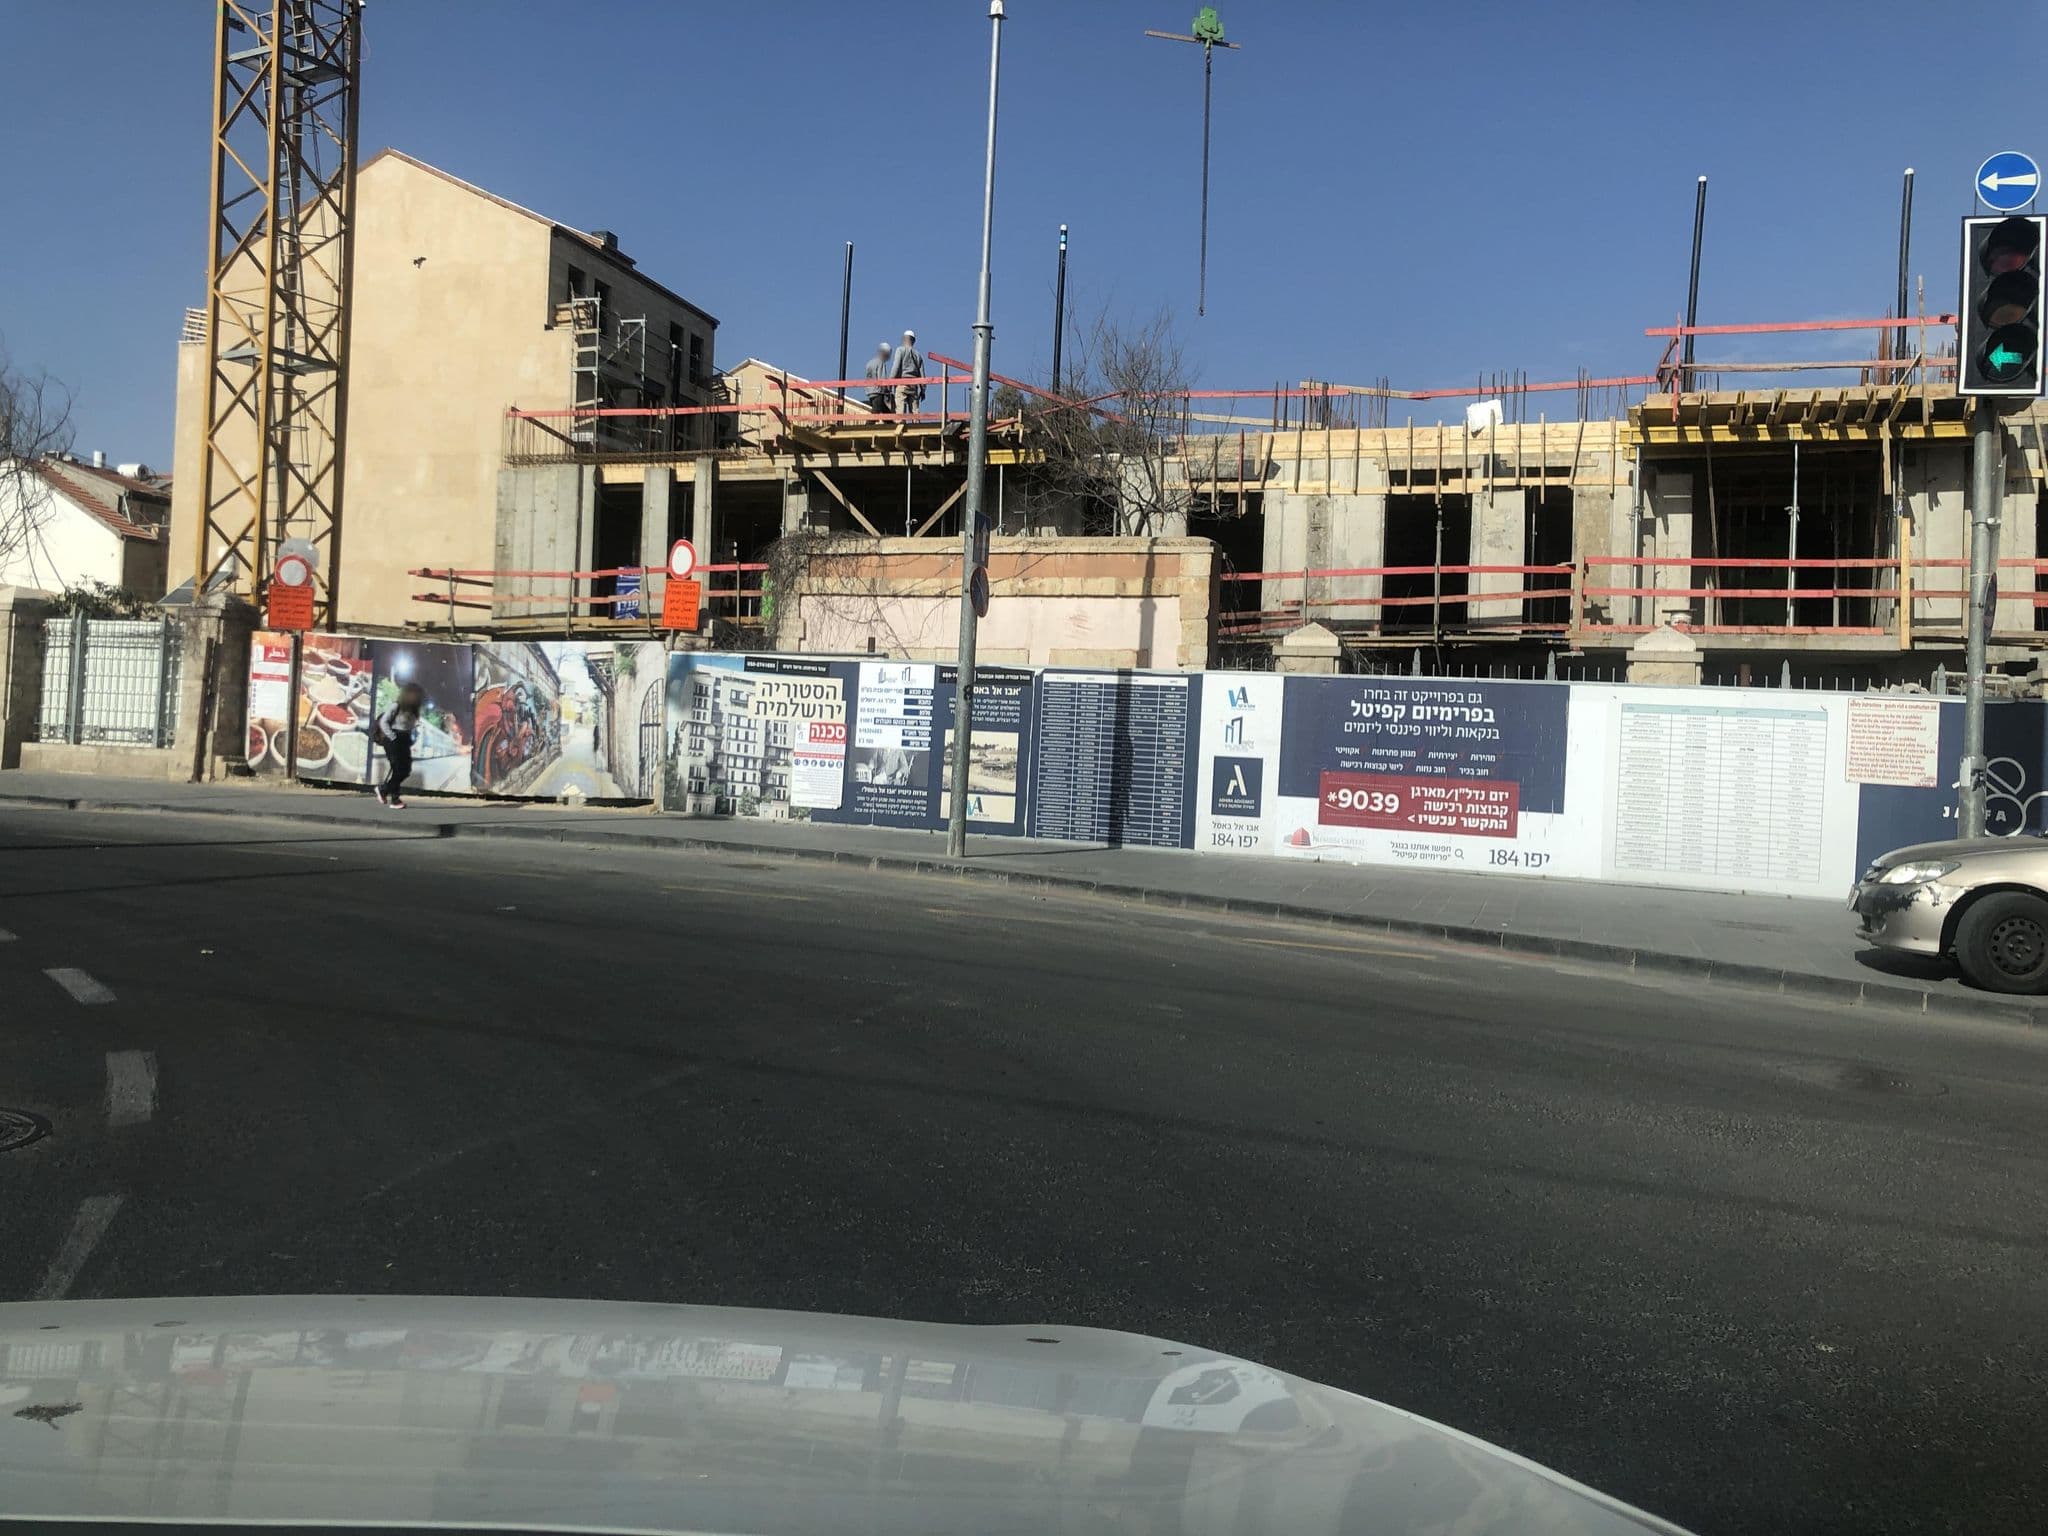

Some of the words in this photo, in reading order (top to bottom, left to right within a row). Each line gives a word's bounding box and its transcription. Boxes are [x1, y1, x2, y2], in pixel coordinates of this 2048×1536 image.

[762, 682, 837, 700] הסטוריה
[992, 685, 1002, 696] אל
[1364, 689, 1390, 700] בחרו
[1394, 690, 1408, 700] זה
[1412, 691, 1464, 704] בפרוייקט
[1468, 693, 1482, 704] גם
[755, 698, 842, 719] ירושלמית
[1351, 700, 1406, 723] קפיטל
[1412, 705, 1495, 723] בפרימיום
[811, 725, 846, 740] סכנה
[1344, 721, 1382, 734] ליזמים
[1385, 724, 1421, 735] פיננסי
[1424, 724, 1452, 738] וליווי
[1455, 726, 1500, 741] בנקאות
[1372, 748, 1399, 757] פתרונות
[1400, 750, 1416, 758] מגוון
[1428, 751, 1458, 760] יצירתיות
[1470, 753, 1495, 762] מהירות
[1340, 760, 1363, 768] רכישה
[1364, 761, 1388, 770] קבוצות
[1416, 765, 1432, 773] נחות
[1433, 766, 1446, 774] חוב
[1459, 767, 1475, 775] בכיר
[1476, 768, 1489, 776] חוב
[1489, 791, 1509, 801] יזם
[1423, 801, 1463, 813] רכישה
[1466, 804, 1508, 817] קבוצות
[1212, 821, 1231, 830] באסל
[1234, 822, 1244, 830] אל
[1418, 815, 1456, 826] עכשיו
[1461, 818, 1507, 831] התקשר
[1246, 824, 1259, 832] אבו
[1212, 833, 1234, 848] 184
[1238, 834, 1259, 848] יפו
[1390, 841, 1409, 850] בגוגל
[1410, 843, 1430, 851] אותנו
[1432, 845, 1451, 853] חפשו
[1489, 849, 1519, 867] 184
[1523, 851, 1550, 868] יפו
